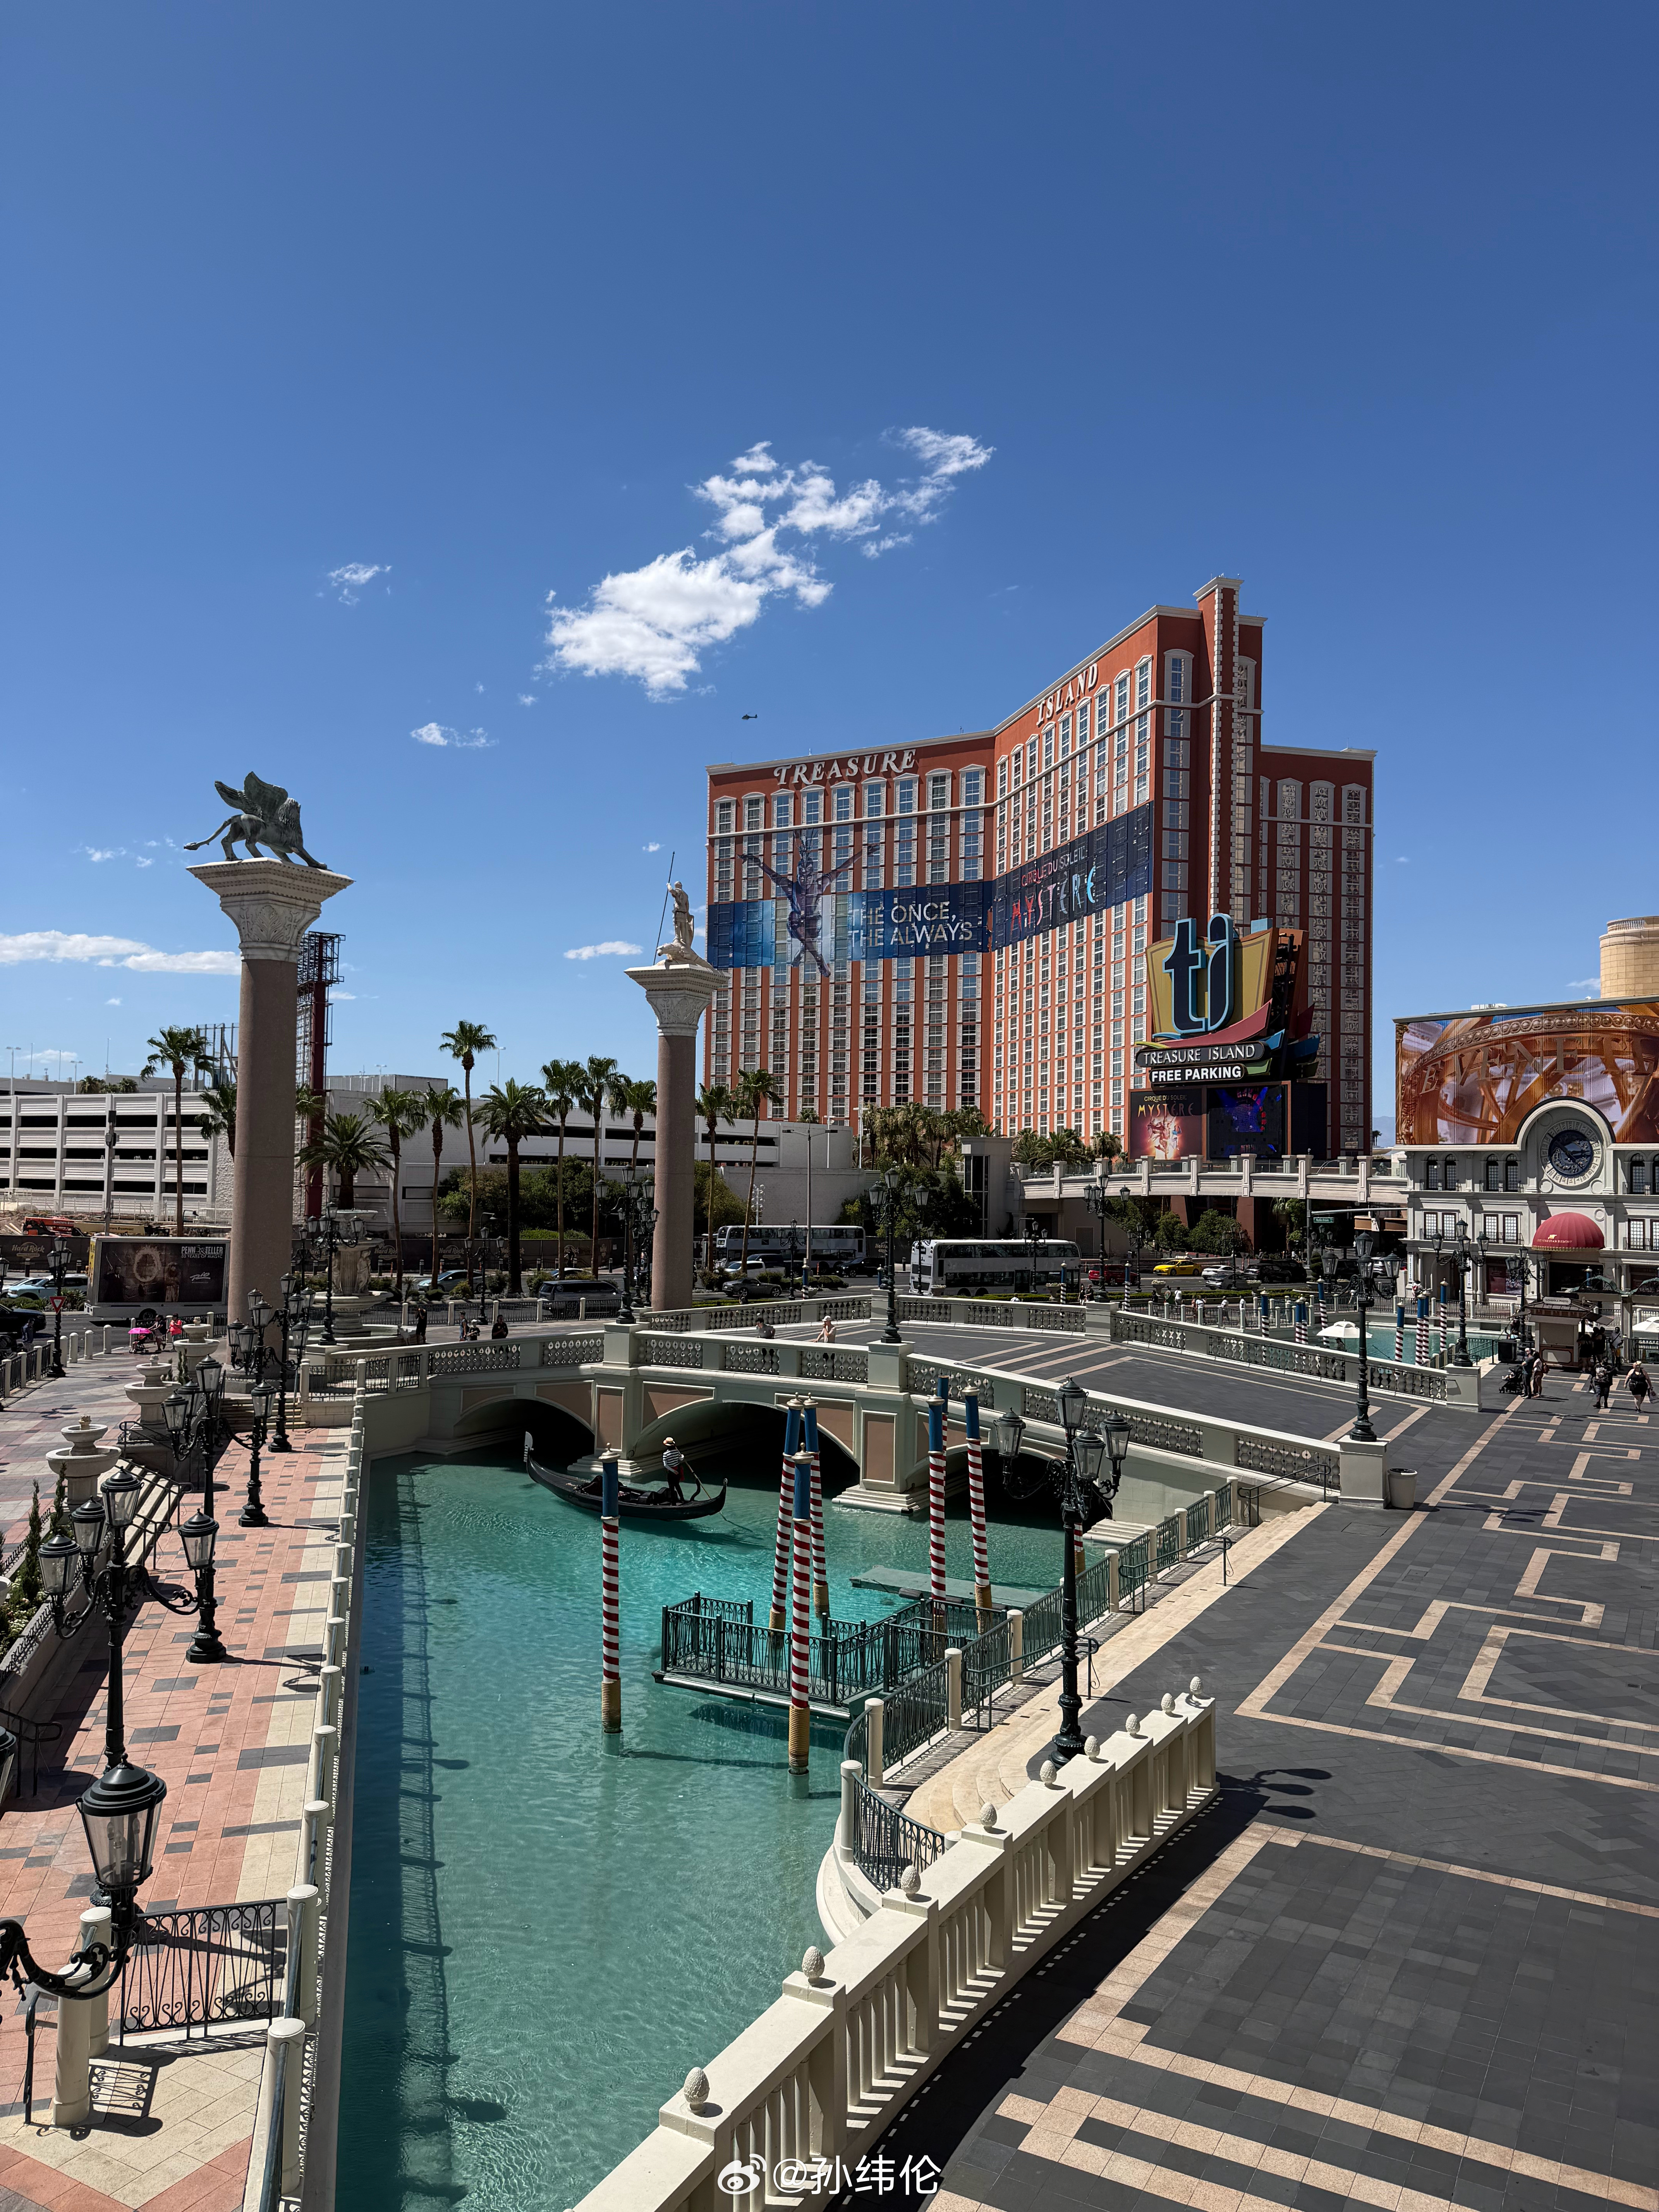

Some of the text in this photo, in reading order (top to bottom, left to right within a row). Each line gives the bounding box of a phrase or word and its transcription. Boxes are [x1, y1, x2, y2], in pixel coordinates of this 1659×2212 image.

[1036, 663, 1098, 726] ISLAND
[774, 749, 916, 785] TREASURE
[1021, 846, 1086, 887] CIRQUE DU SOLEIL
[848, 901, 956, 926] THE ONCE,
[848, 922, 973, 947] THE ALWAYS
[1143, 1044, 1255, 1065] TREASURE ISLAND
[1152, 1066, 1241, 1082] FREE PARKING
[1138, 1101, 1194, 1118] MYSTÈRE
[29, 1245, 45, 1253] Rock
[181, 1246, 196, 1254] PENN
[205, 1247, 223, 1255] TELLER
